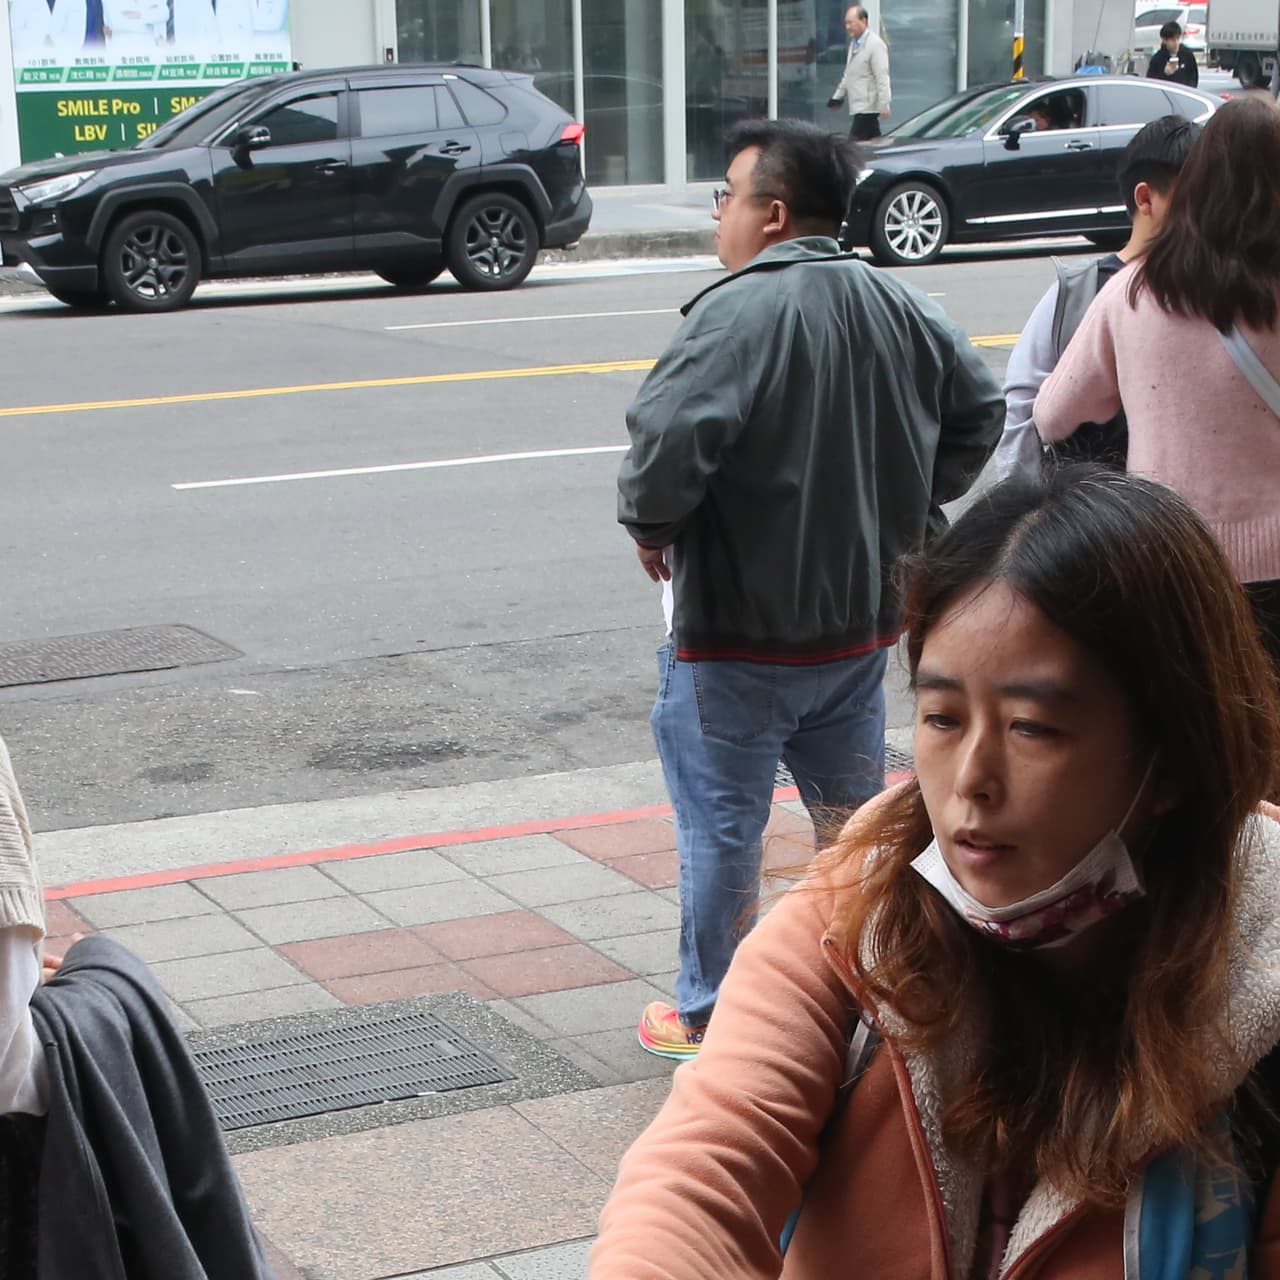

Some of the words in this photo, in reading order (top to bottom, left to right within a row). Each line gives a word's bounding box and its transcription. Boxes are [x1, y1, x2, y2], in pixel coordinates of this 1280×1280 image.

[58, 100, 109, 117] SMILE
[113, 98, 141, 116] Pro
[171, 97, 203, 113] SM
[75, 125, 107, 142] LBV
